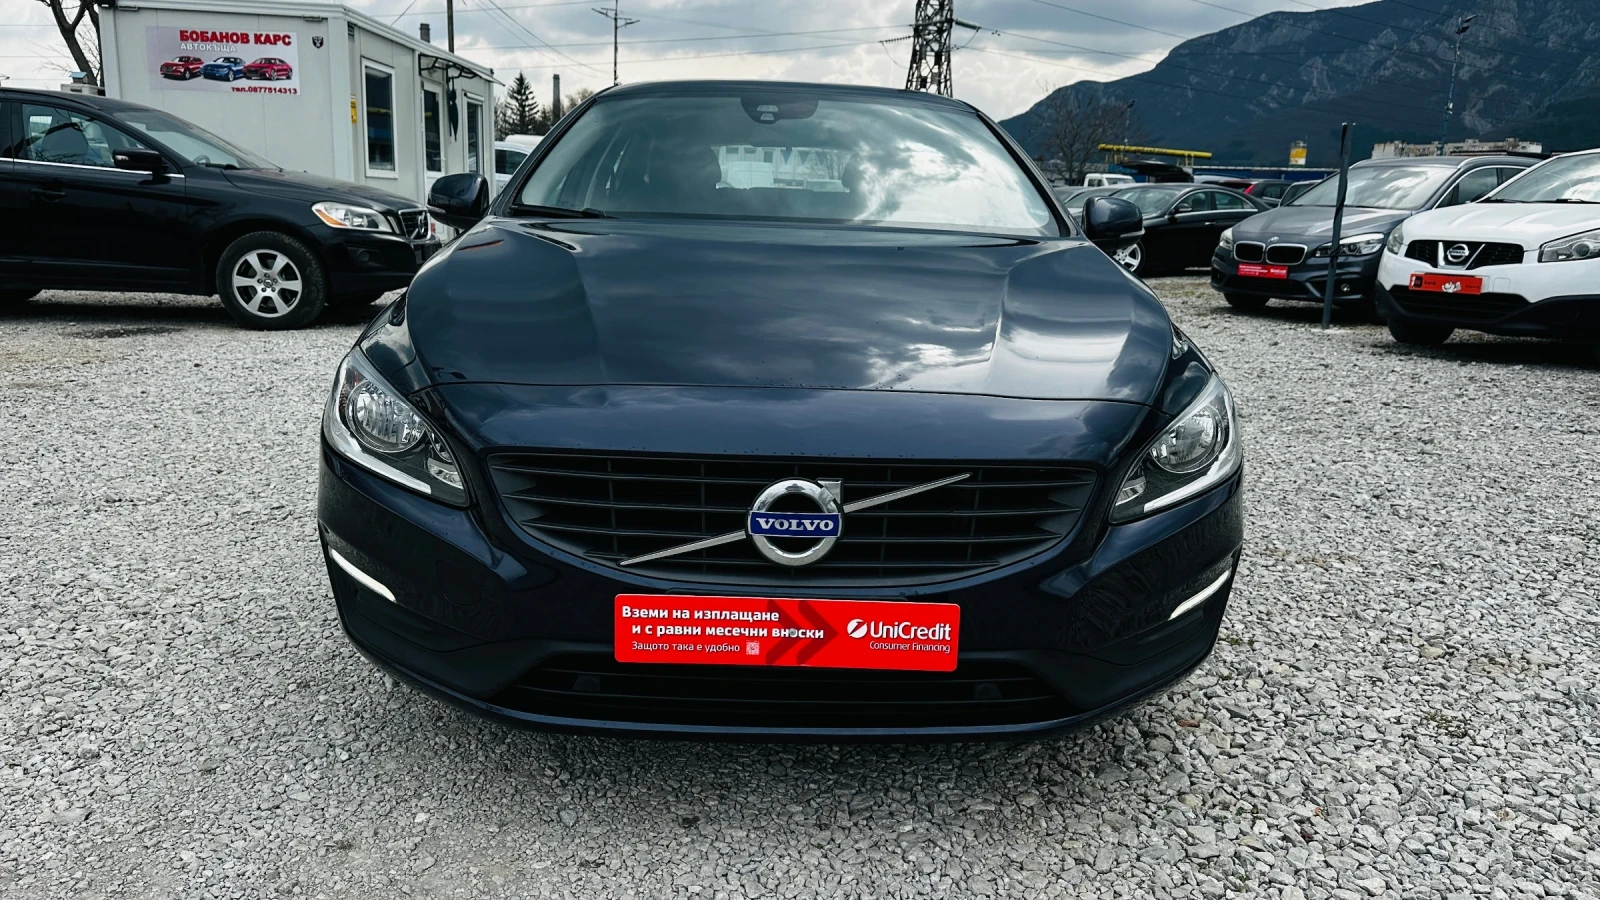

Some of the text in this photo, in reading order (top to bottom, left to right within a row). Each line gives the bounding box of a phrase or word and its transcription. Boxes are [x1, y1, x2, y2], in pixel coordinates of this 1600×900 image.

[179, 30, 292, 46] БОБАНОВ КАРС
[180, 43, 237, 52] АВТОКЪЩА
[756, 518, 834, 531] VOLVO
[622, 605, 779, 622] Вземи на изплащане
[632, 625, 641, 634] и
[645, 625, 653, 634] с
[657, 625, 701, 637] равни
[705, 626, 768, 637] месечни
[870, 621, 952, 641] UniCredit
[632, 641, 669, 651] Защото
[705, 643, 740, 653] удобно
[869, 641, 950, 654] Consumer Financing
